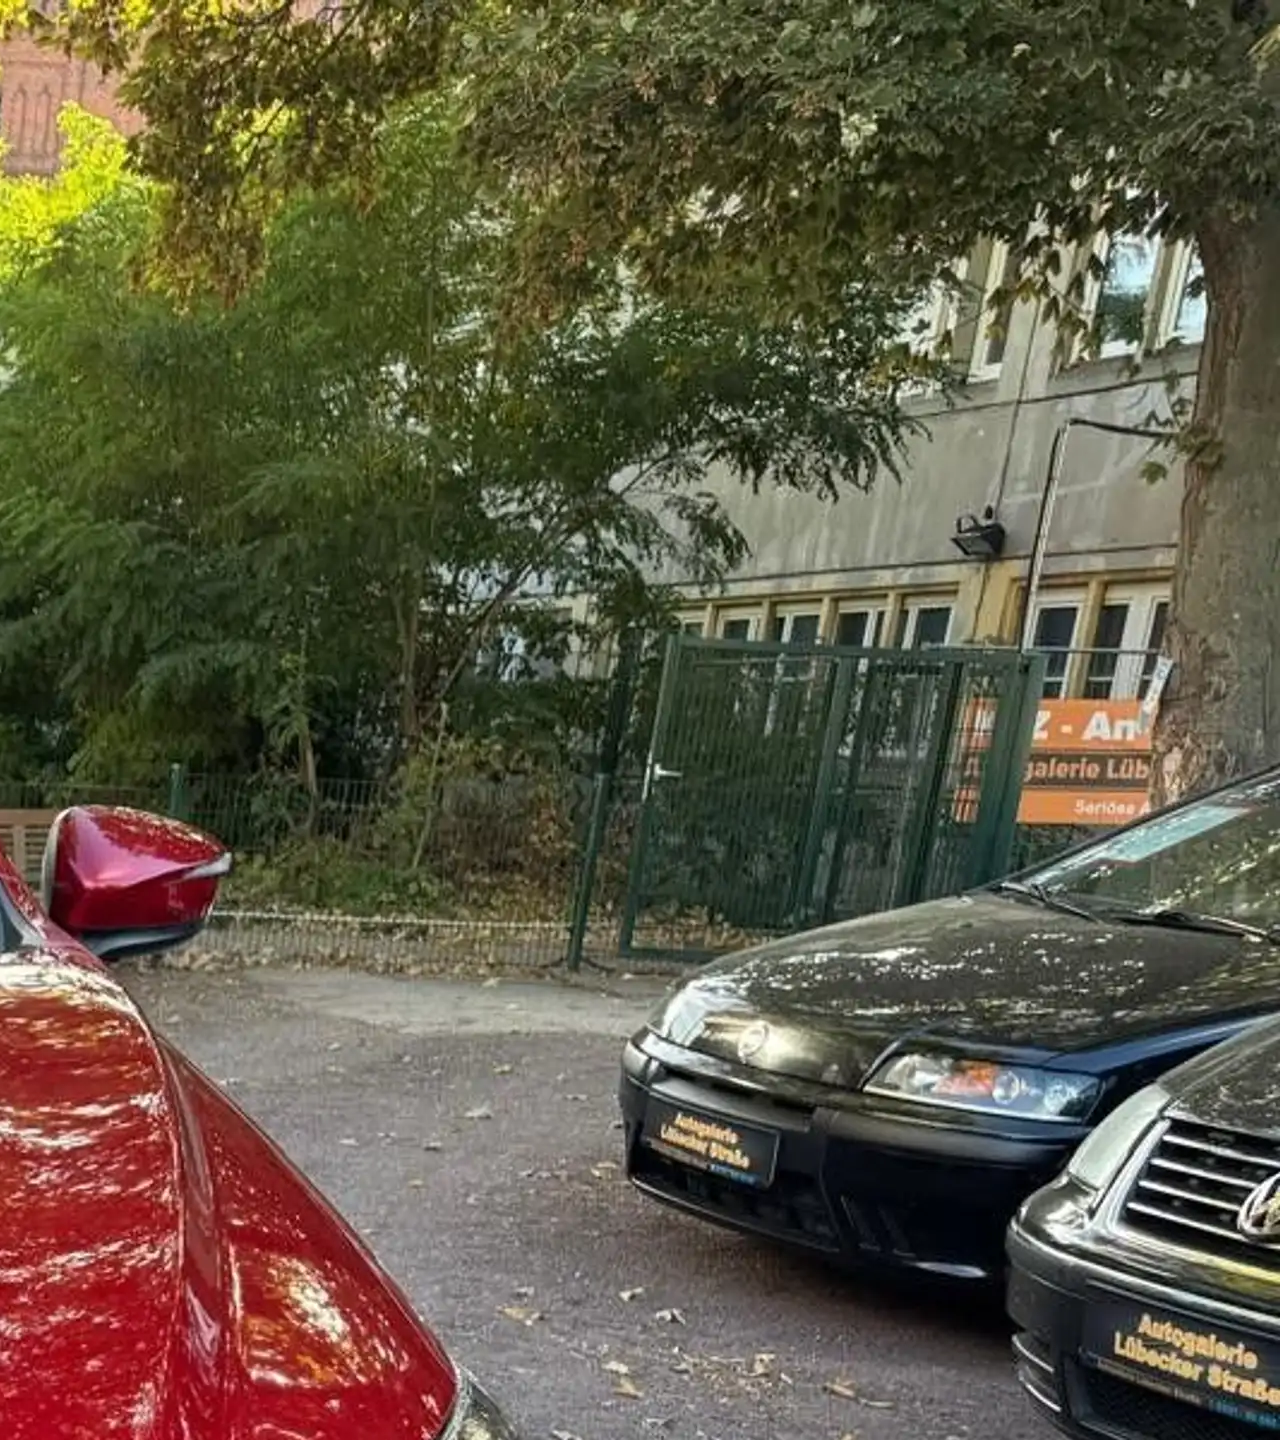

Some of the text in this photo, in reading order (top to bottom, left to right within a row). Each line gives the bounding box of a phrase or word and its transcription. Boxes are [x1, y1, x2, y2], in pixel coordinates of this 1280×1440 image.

[1083, 711, 1148, 740] An
[1107, 759, 1149, 779] Lüb
[1113, 1330, 1204, 1381] Lübecker
[1138, 1312, 1258, 1370] Autogalerie
